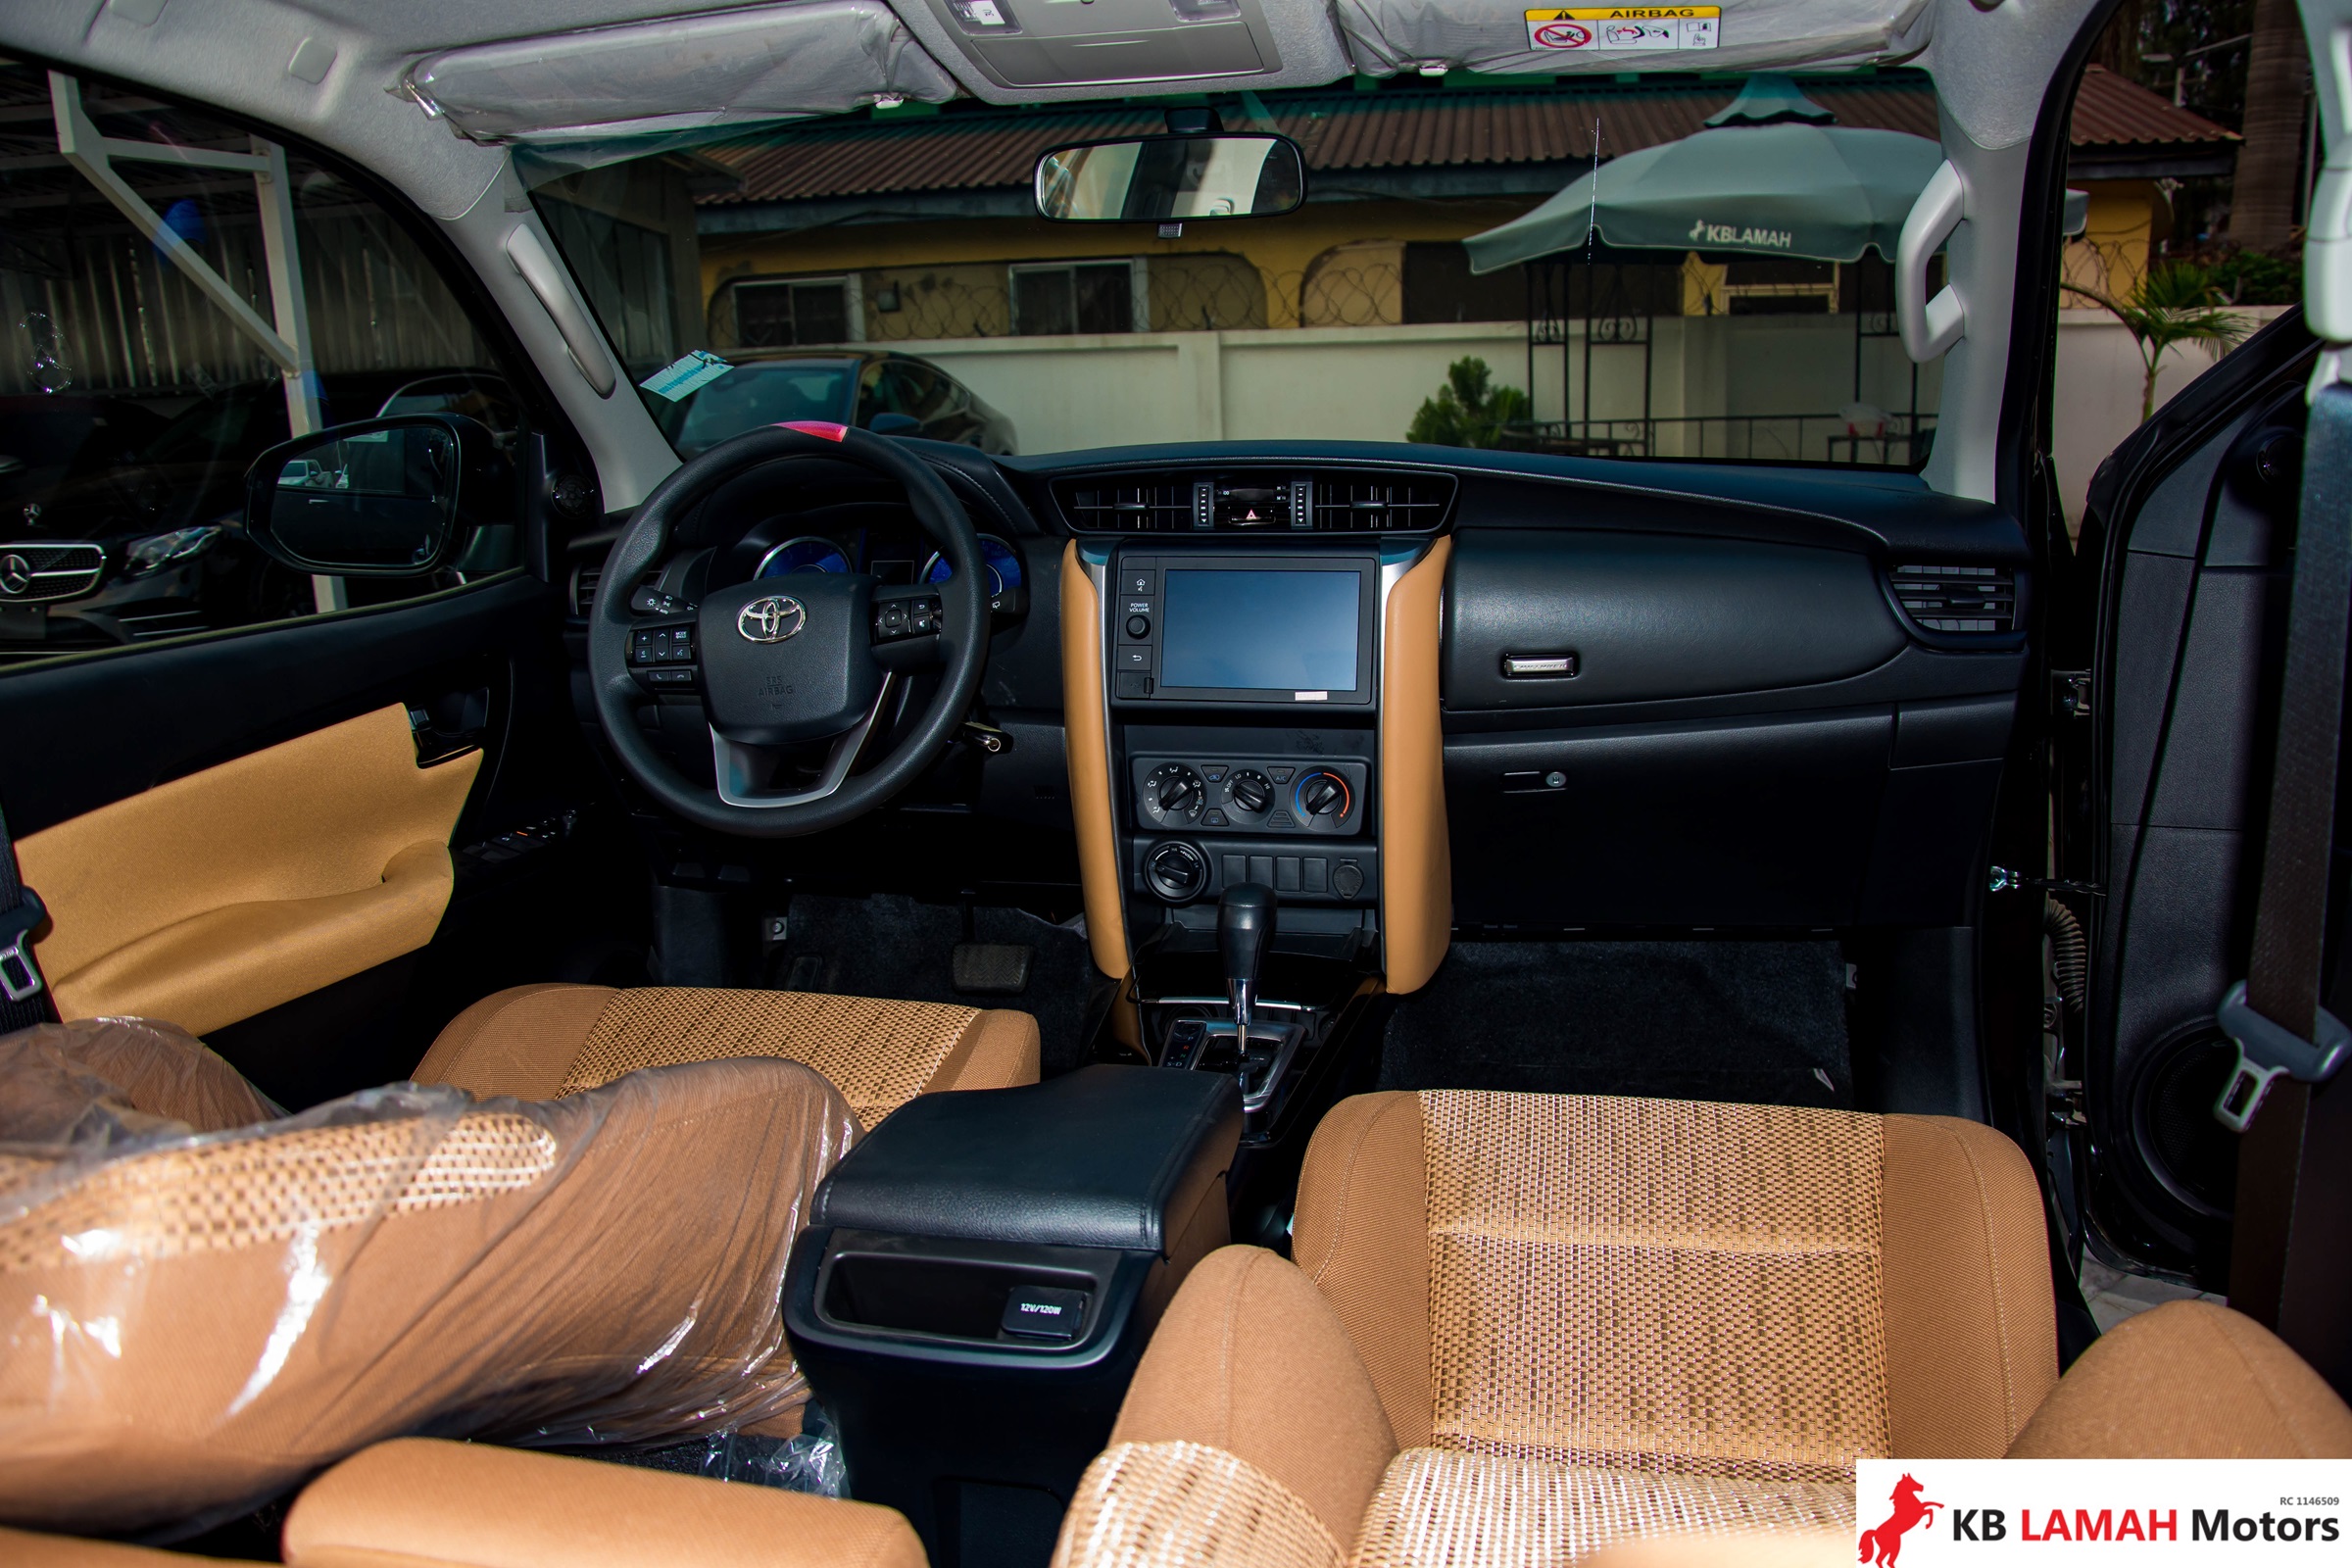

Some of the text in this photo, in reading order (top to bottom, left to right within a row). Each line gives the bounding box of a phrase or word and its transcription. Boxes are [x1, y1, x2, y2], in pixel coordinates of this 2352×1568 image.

[1609, 9, 1695, 19] AIRBAG
[765, 676, 783, 685] SRS
[758, 685, 794, 697] AIRBAG
[1020, 1302, 1062, 1315] 12V/120W
